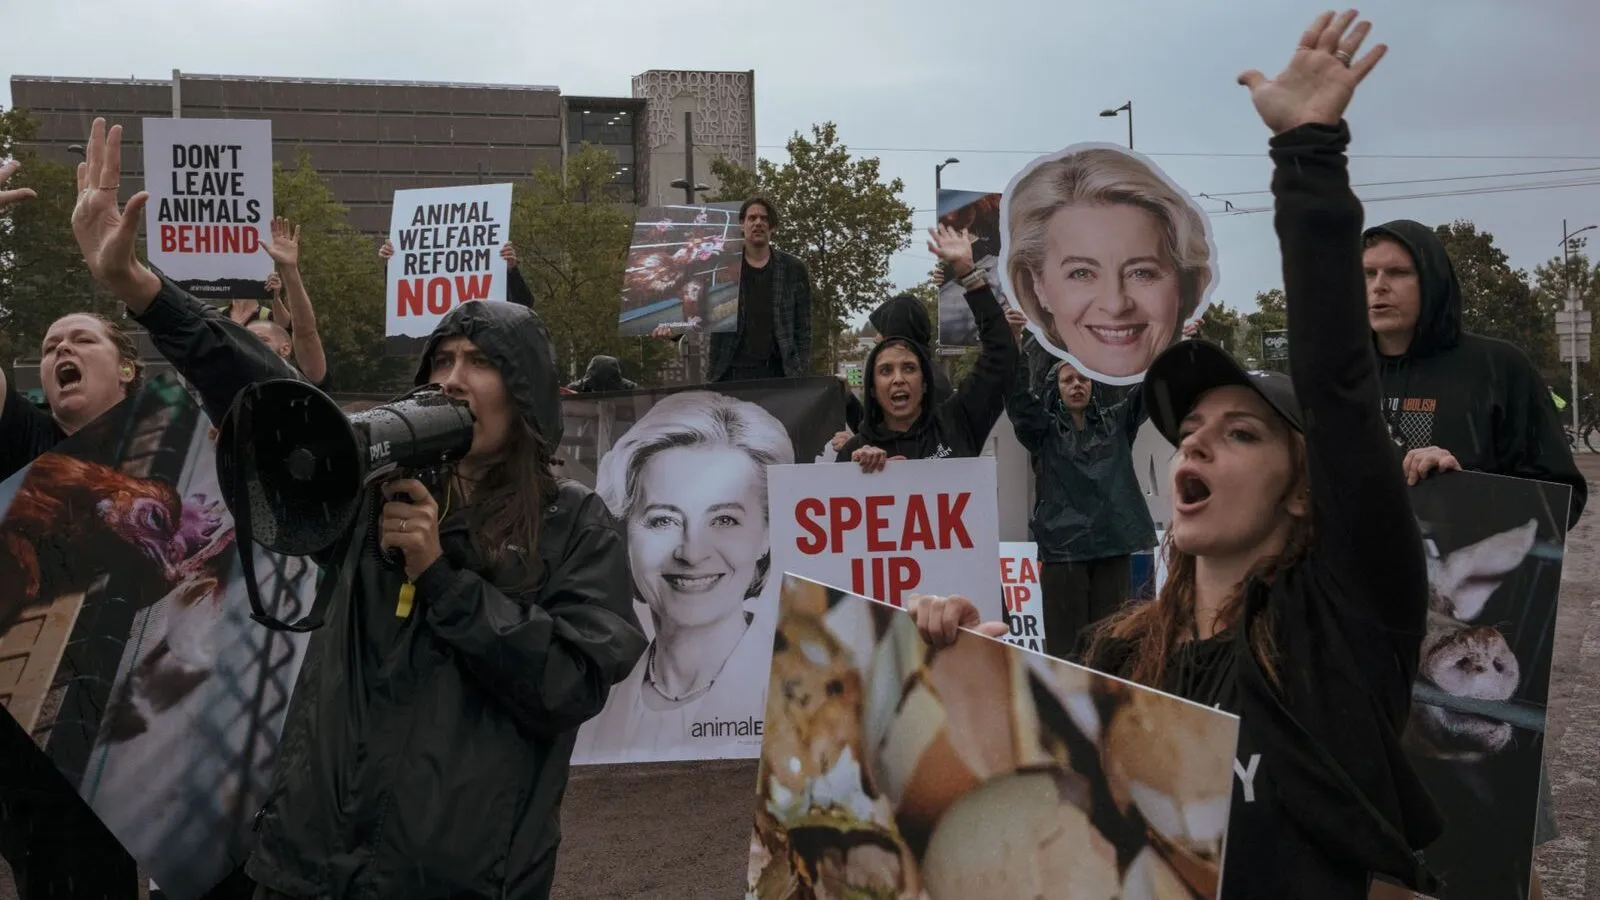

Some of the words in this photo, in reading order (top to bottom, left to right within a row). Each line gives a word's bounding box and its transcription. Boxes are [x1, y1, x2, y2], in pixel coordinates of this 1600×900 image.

[172, 144, 242, 169] DON'T
[172, 171, 245, 196] LEAVE
[158, 198, 261, 223] ANIMALS
[411, 201, 495, 226] ANIMAL
[160, 224, 260, 254] BEHIND
[398, 224, 501, 251] WELFARE
[403, 248, 491, 276] REFORM
[396, 274, 493, 317] NOW
[794, 492, 975, 555] SPEAK
[851, 556, 922, 608] UP
[1000, 557, 1042, 584] EA
[1009, 614, 1039, 637] OR
[691, 715, 764, 738] animalE
